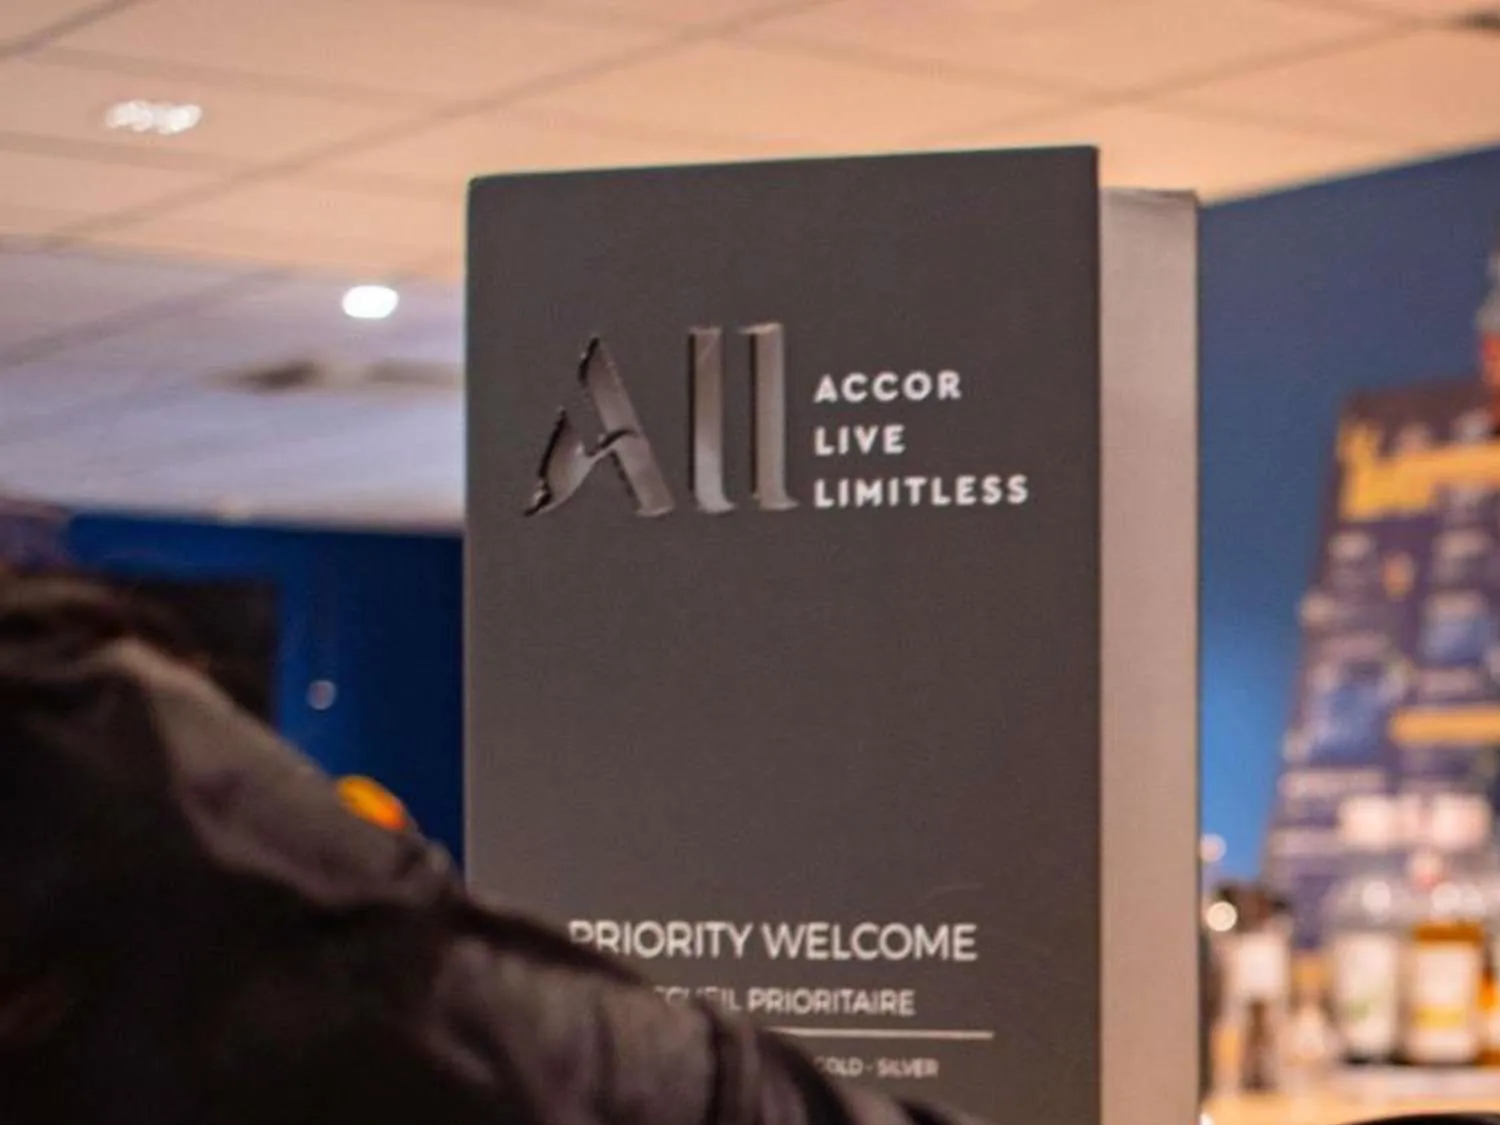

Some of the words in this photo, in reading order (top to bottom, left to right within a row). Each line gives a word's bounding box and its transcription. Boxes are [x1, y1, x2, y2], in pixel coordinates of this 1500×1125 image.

[813, 370, 962, 403] ACCOR
[813, 424, 906, 456] LIVE
[813, 474, 1029, 508] LIMITLESS
[568, 919, 754, 960] PRIORITY
[760, 921, 978, 962] WELCOME
[747, 986, 917, 1017] PRIORITAIRE
[876, 1057, 940, 1079] SILVER
